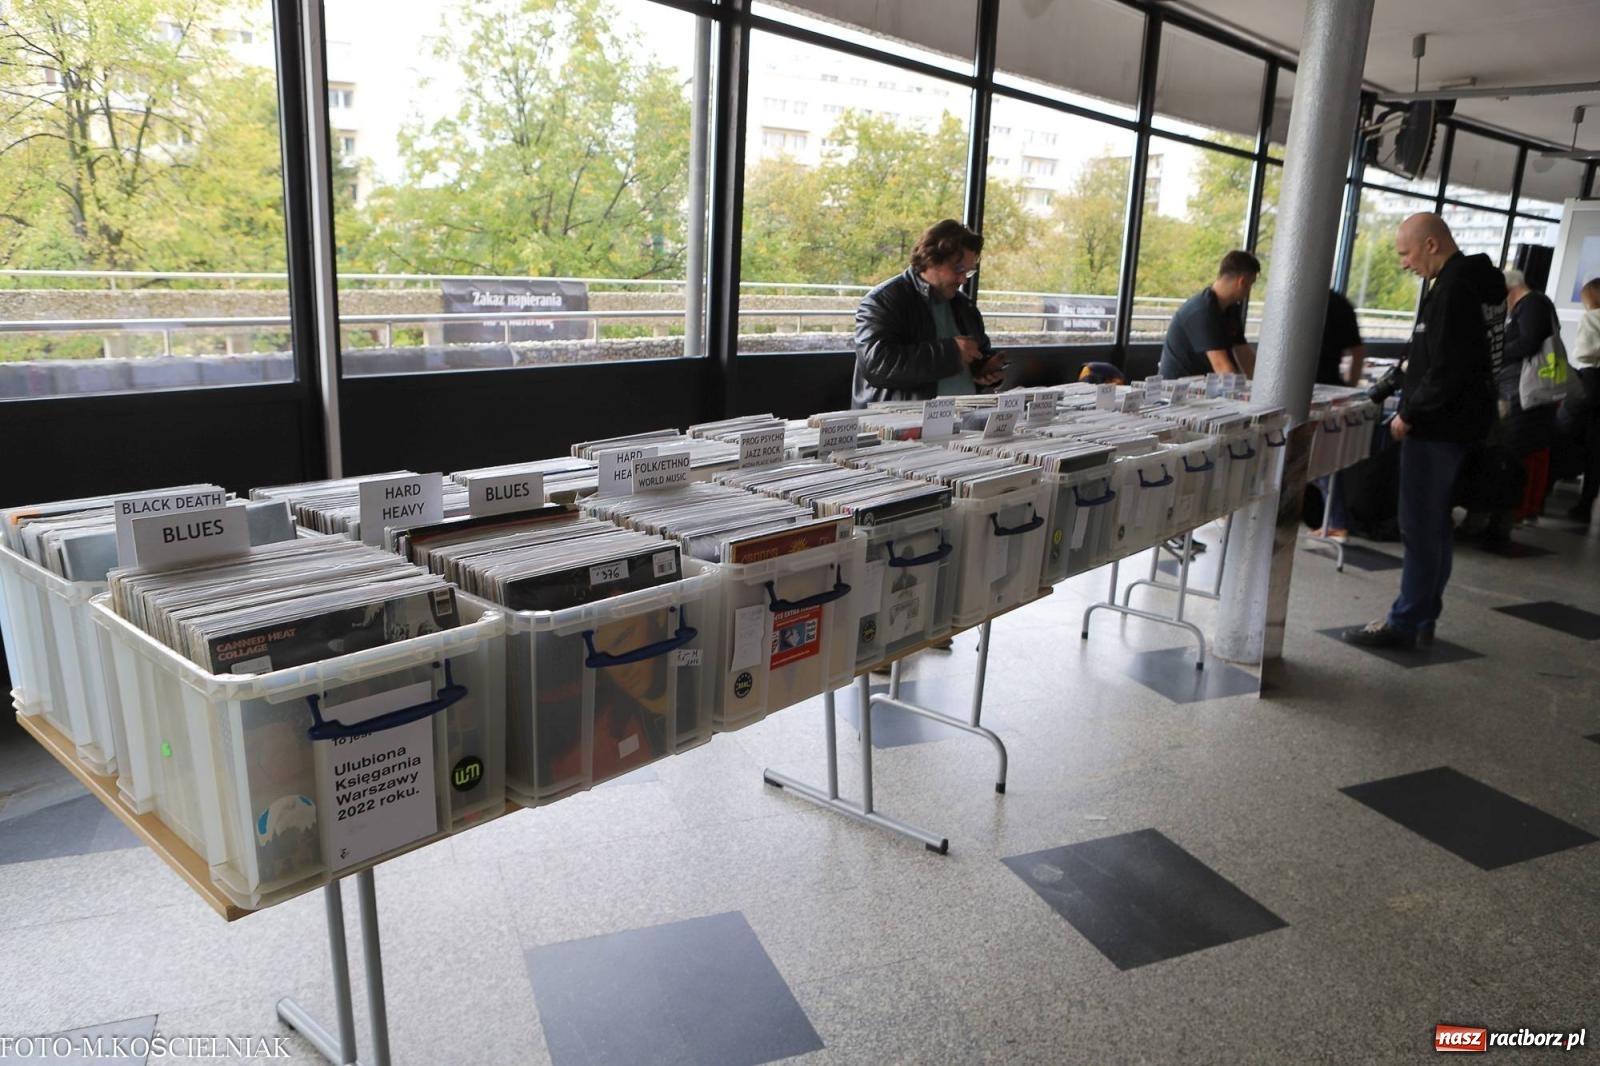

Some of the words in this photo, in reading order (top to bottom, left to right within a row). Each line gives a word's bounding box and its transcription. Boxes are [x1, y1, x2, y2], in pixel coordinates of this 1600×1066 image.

[472, 291, 505, 306] Zakaz
[507, 292, 562, 309] napierania
[742, 436, 759, 445] PROG
[760, 432, 784, 443] PSYCHO
[823, 437, 837, 447] JAZZ
[839, 435, 854, 443] ROCK
[617, 450, 643, 463] HARD
[745, 448, 761, 459] JAZZ
[763, 446, 781, 456] ROCK
[635, 457, 690, 474] FOLK/ETHNO
[614, 469, 633, 481] HEA
[639, 475, 664, 487] WORLD
[666, 472, 687, 482] MUSIC
[385, 483, 421, 500] HARD
[485, 482, 530, 502] BLUES
[122, 497, 172, 515] BLACK
[175, 493, 222, 509] DEATH
[382, 502, 425, 521] HEAVY
[163, 519, 224, 544] BLUES
[216, 635, 267, 652] CANNED
[267, 628, 297, 641] HEAT
[218, 643, 268, 660] COLLAGE
[334, 746, 407, 777] Ulubiona
[335, 756, 421, 792] Księgarnia
[336, 771, 419, 807] Warszawy
[338, 799, 376, 821] 2022
[380, 787, 420, 807] roku.
